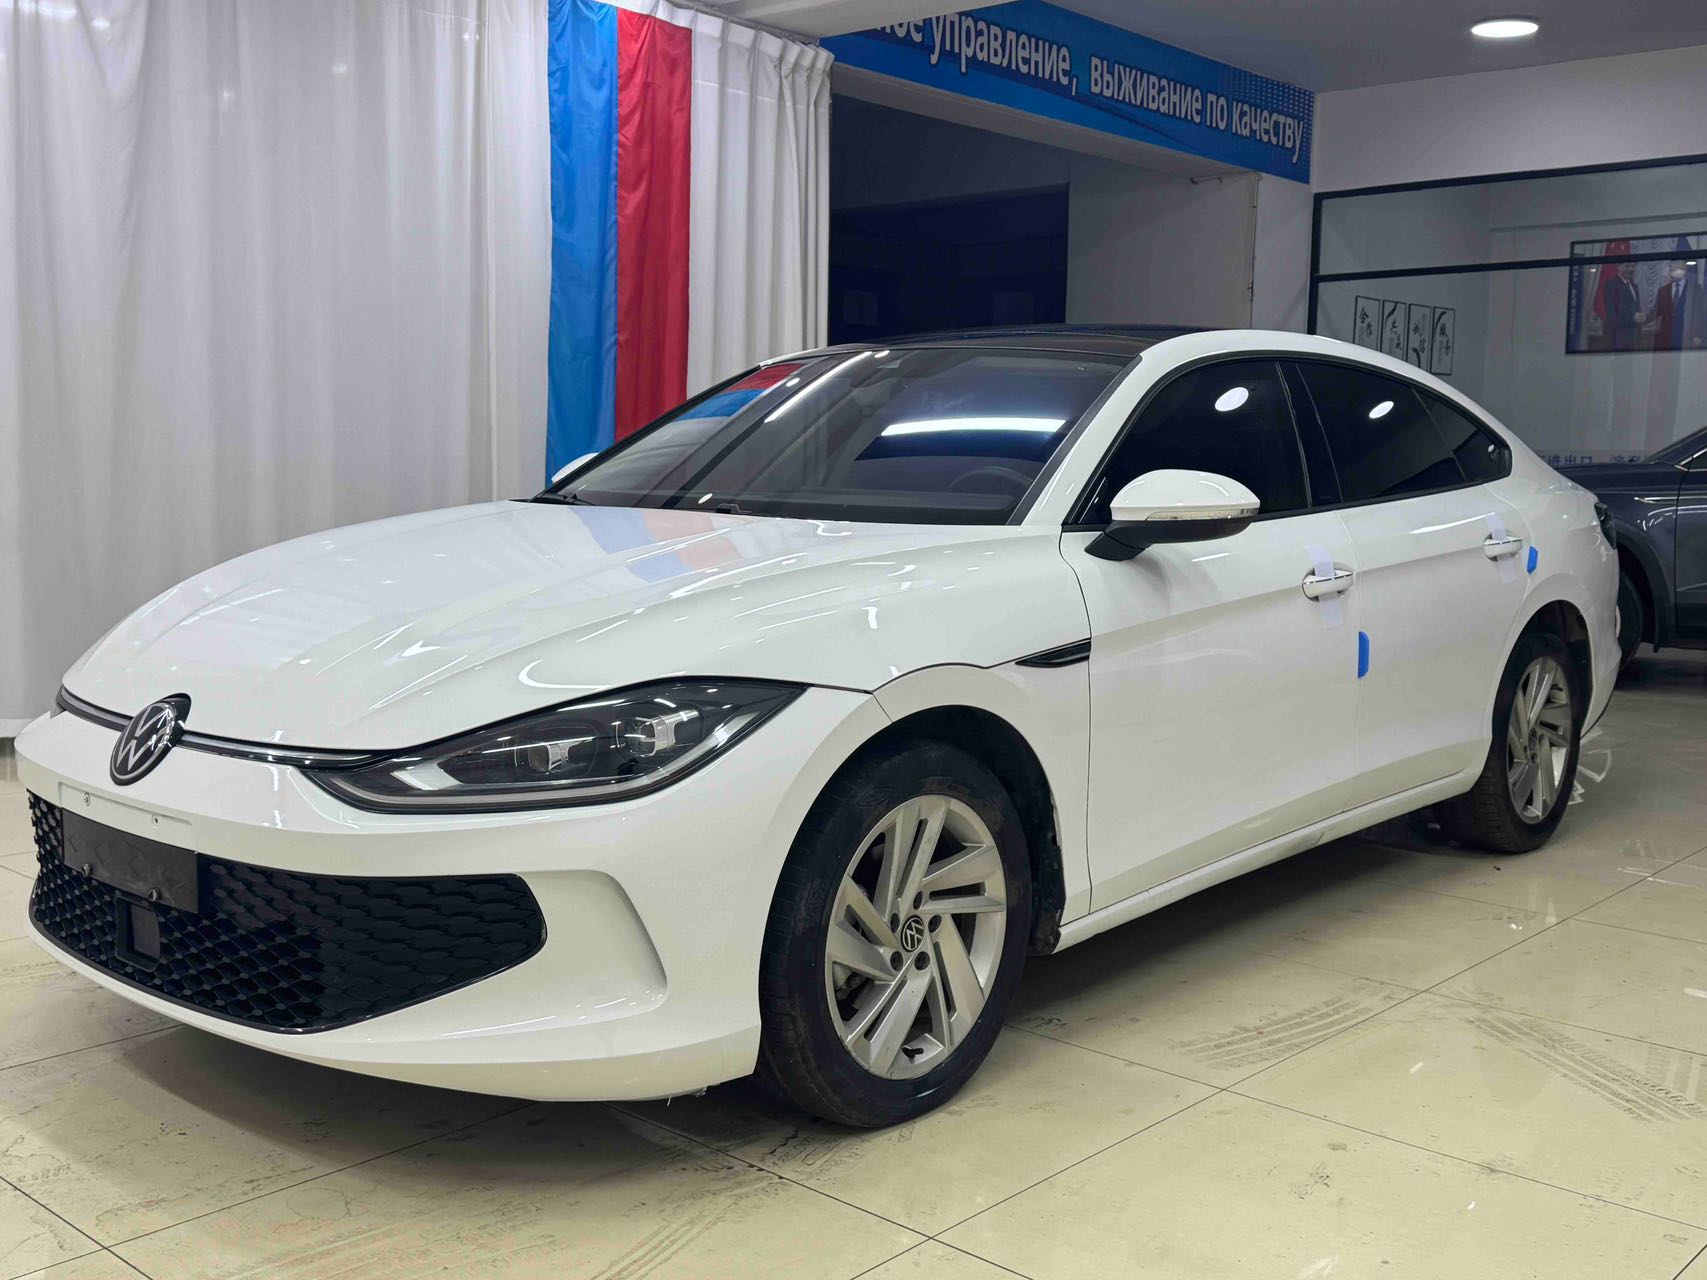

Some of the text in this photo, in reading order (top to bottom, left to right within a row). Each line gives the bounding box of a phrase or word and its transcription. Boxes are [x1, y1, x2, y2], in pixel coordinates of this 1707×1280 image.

[885, 13, 1304, 164] ое управление, выживание по качеству
